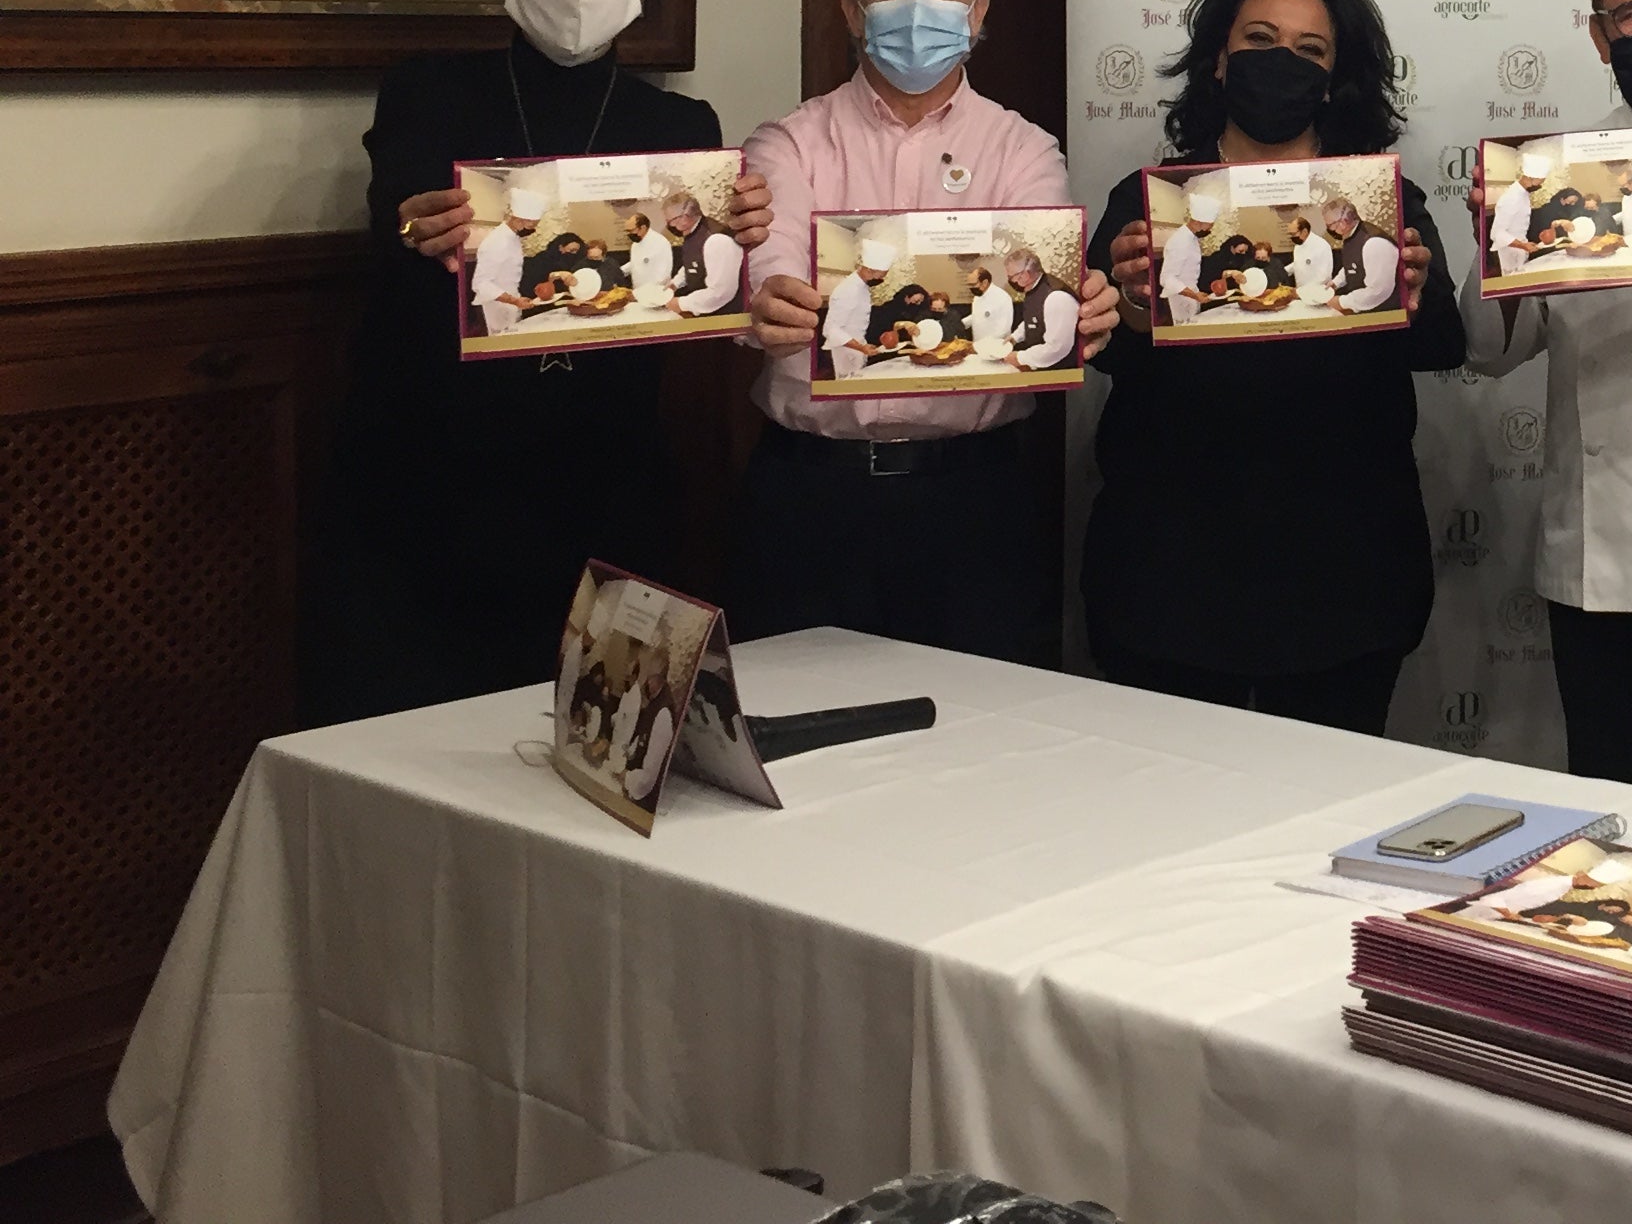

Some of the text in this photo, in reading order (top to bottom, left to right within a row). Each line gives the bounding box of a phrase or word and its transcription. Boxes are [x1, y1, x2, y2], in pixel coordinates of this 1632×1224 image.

[1141, 8, 1171, 29] José
[1433, 0, 1491, 18] agrocorte
[1572, 9, 1588, 29] Jo
